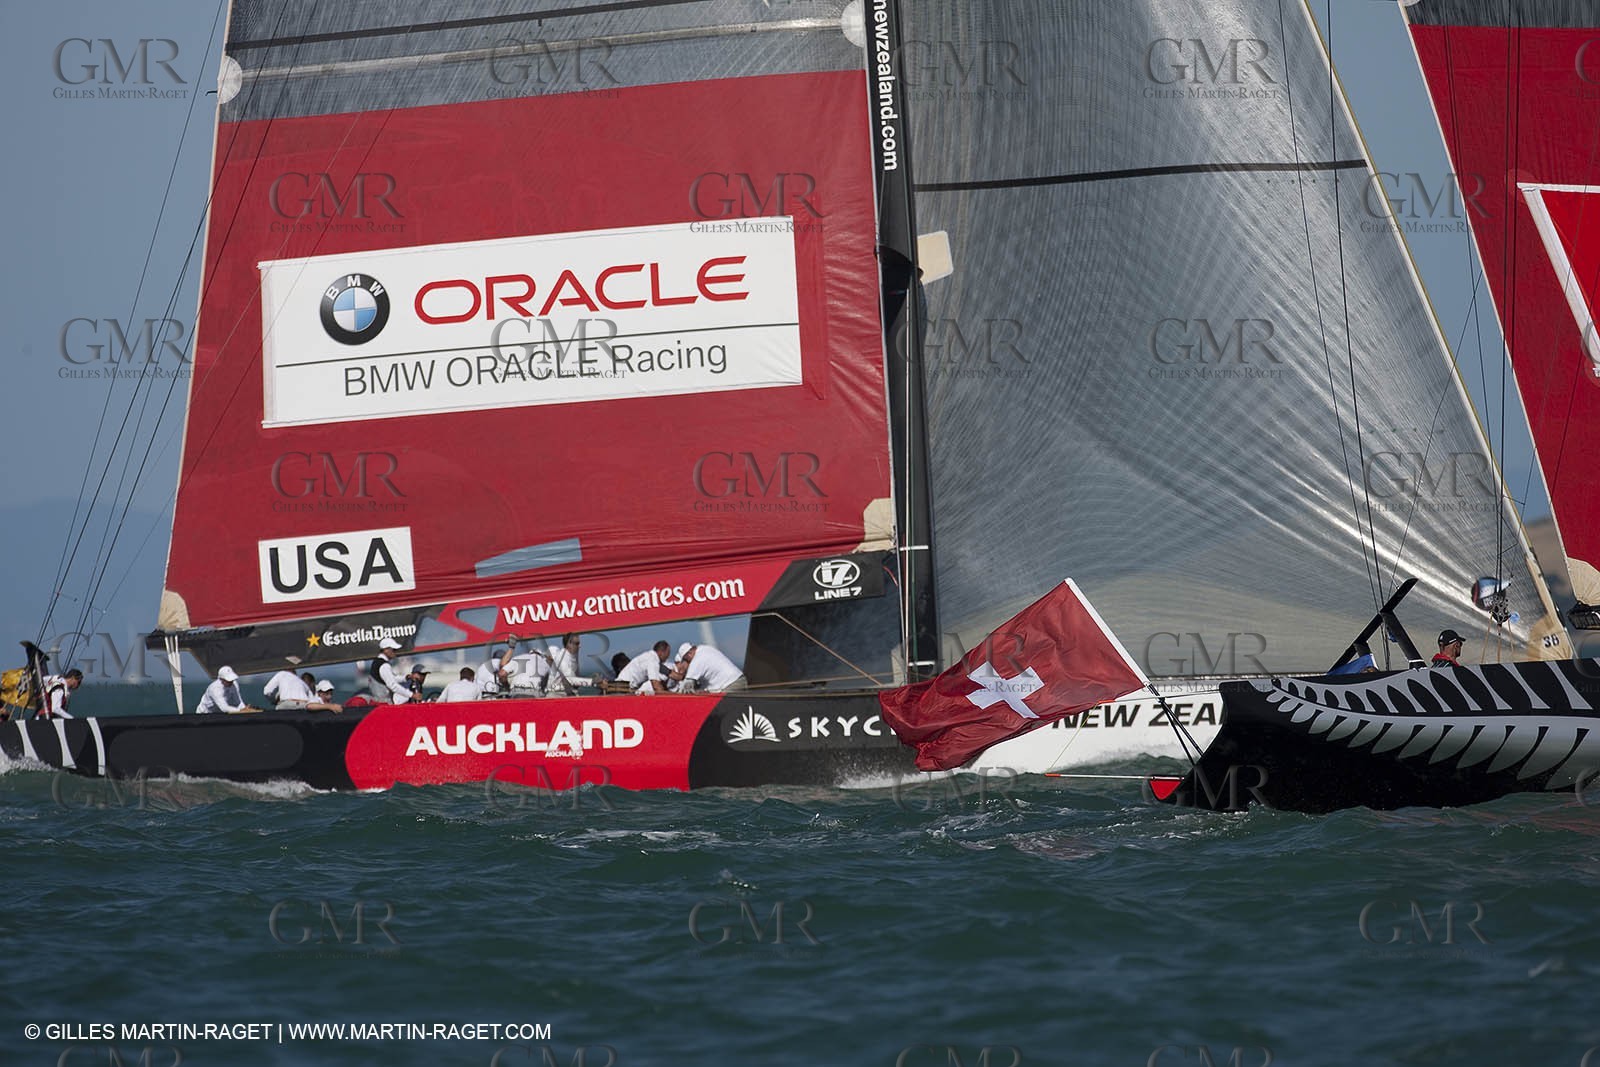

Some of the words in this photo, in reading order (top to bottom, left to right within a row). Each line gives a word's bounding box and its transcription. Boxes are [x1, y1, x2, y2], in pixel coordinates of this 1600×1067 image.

[873, 0, 898, 170] newzealand.com
[325, 274, 385, 301] BMW
[414, 255, 750, 325] ORACLE
[344, 359, 436, 397] BMW
[446, 346, 601, 388] ORACLE
[611, 340, 728, 374] Racing
[269, 536, 404, 594] USA
[502, 578, 745, 625] www.emirates.com
[406, 718, 644, 757] AUCKLAND
[788, 715, 897, 738] SKYC
[1052, 704, 1141, 729] NEW
